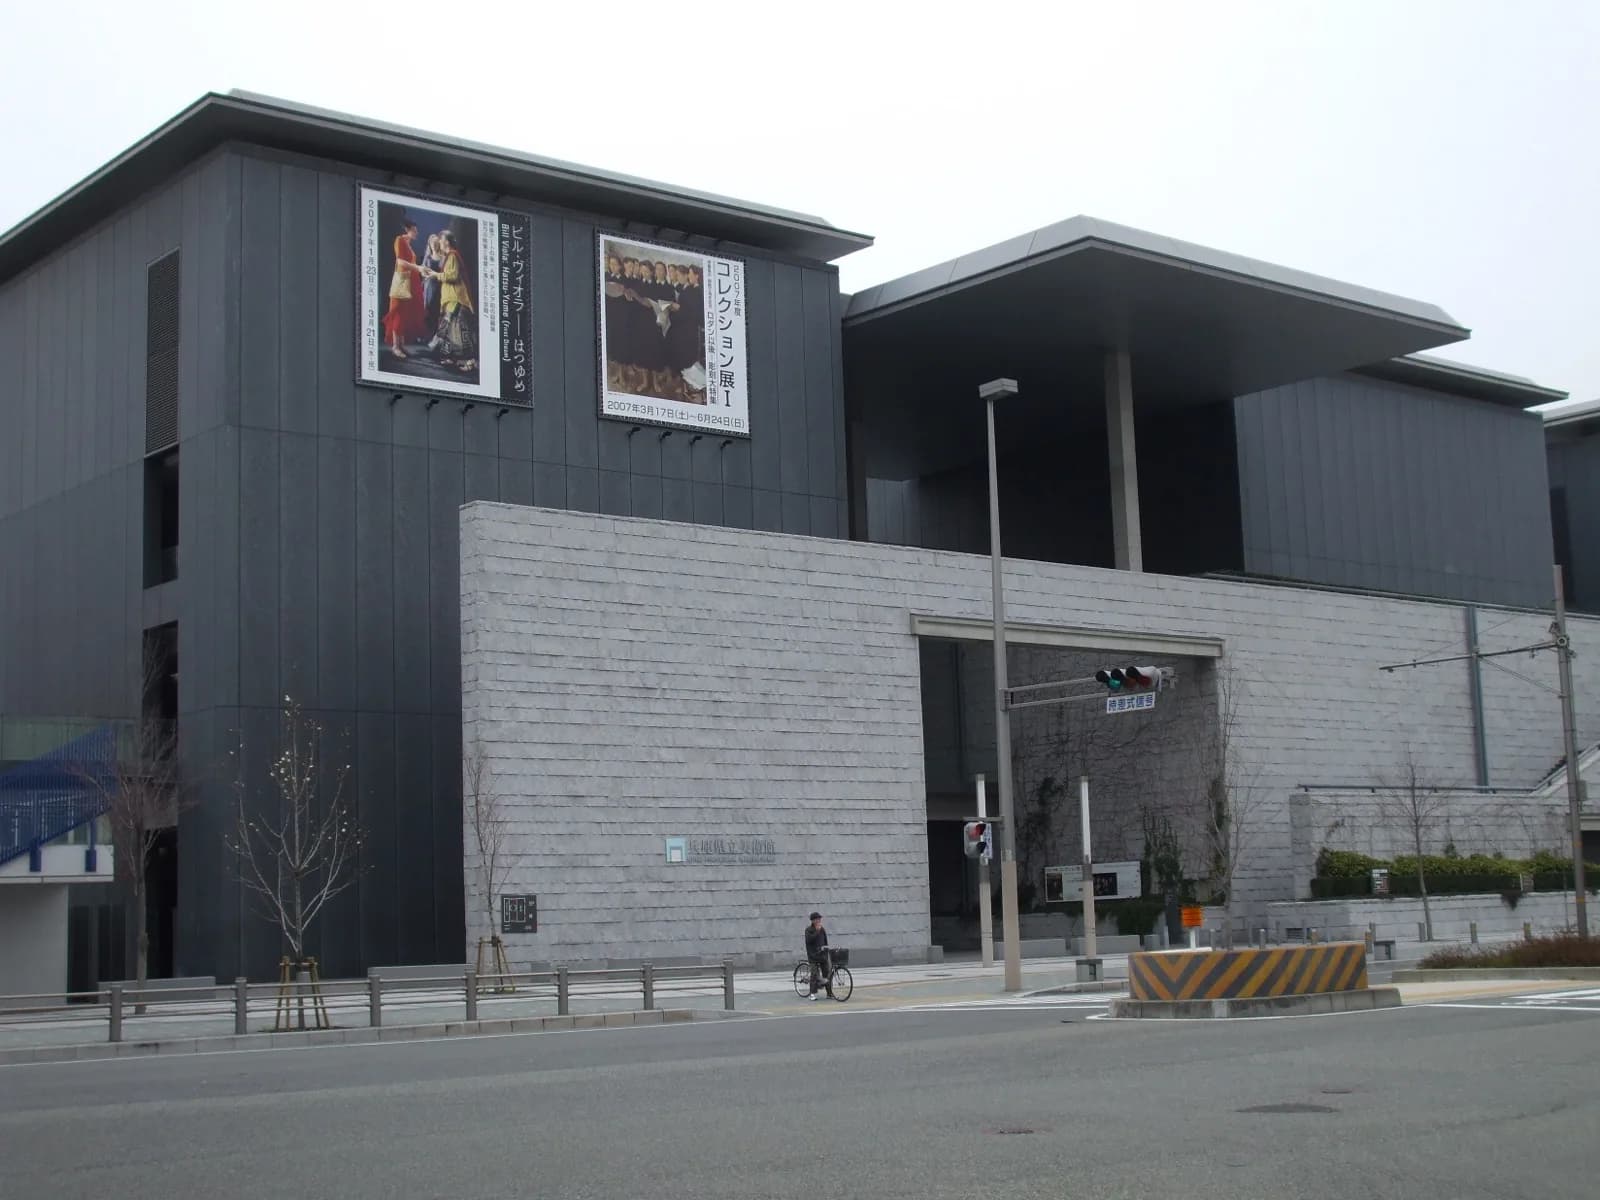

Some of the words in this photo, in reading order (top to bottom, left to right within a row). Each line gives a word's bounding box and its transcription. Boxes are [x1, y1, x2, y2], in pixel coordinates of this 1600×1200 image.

[502, 223, 510, 238] Bill
[502, 240, 510, 264] Viola:
[502, 266, 511, 318] Hatsu-Yume
